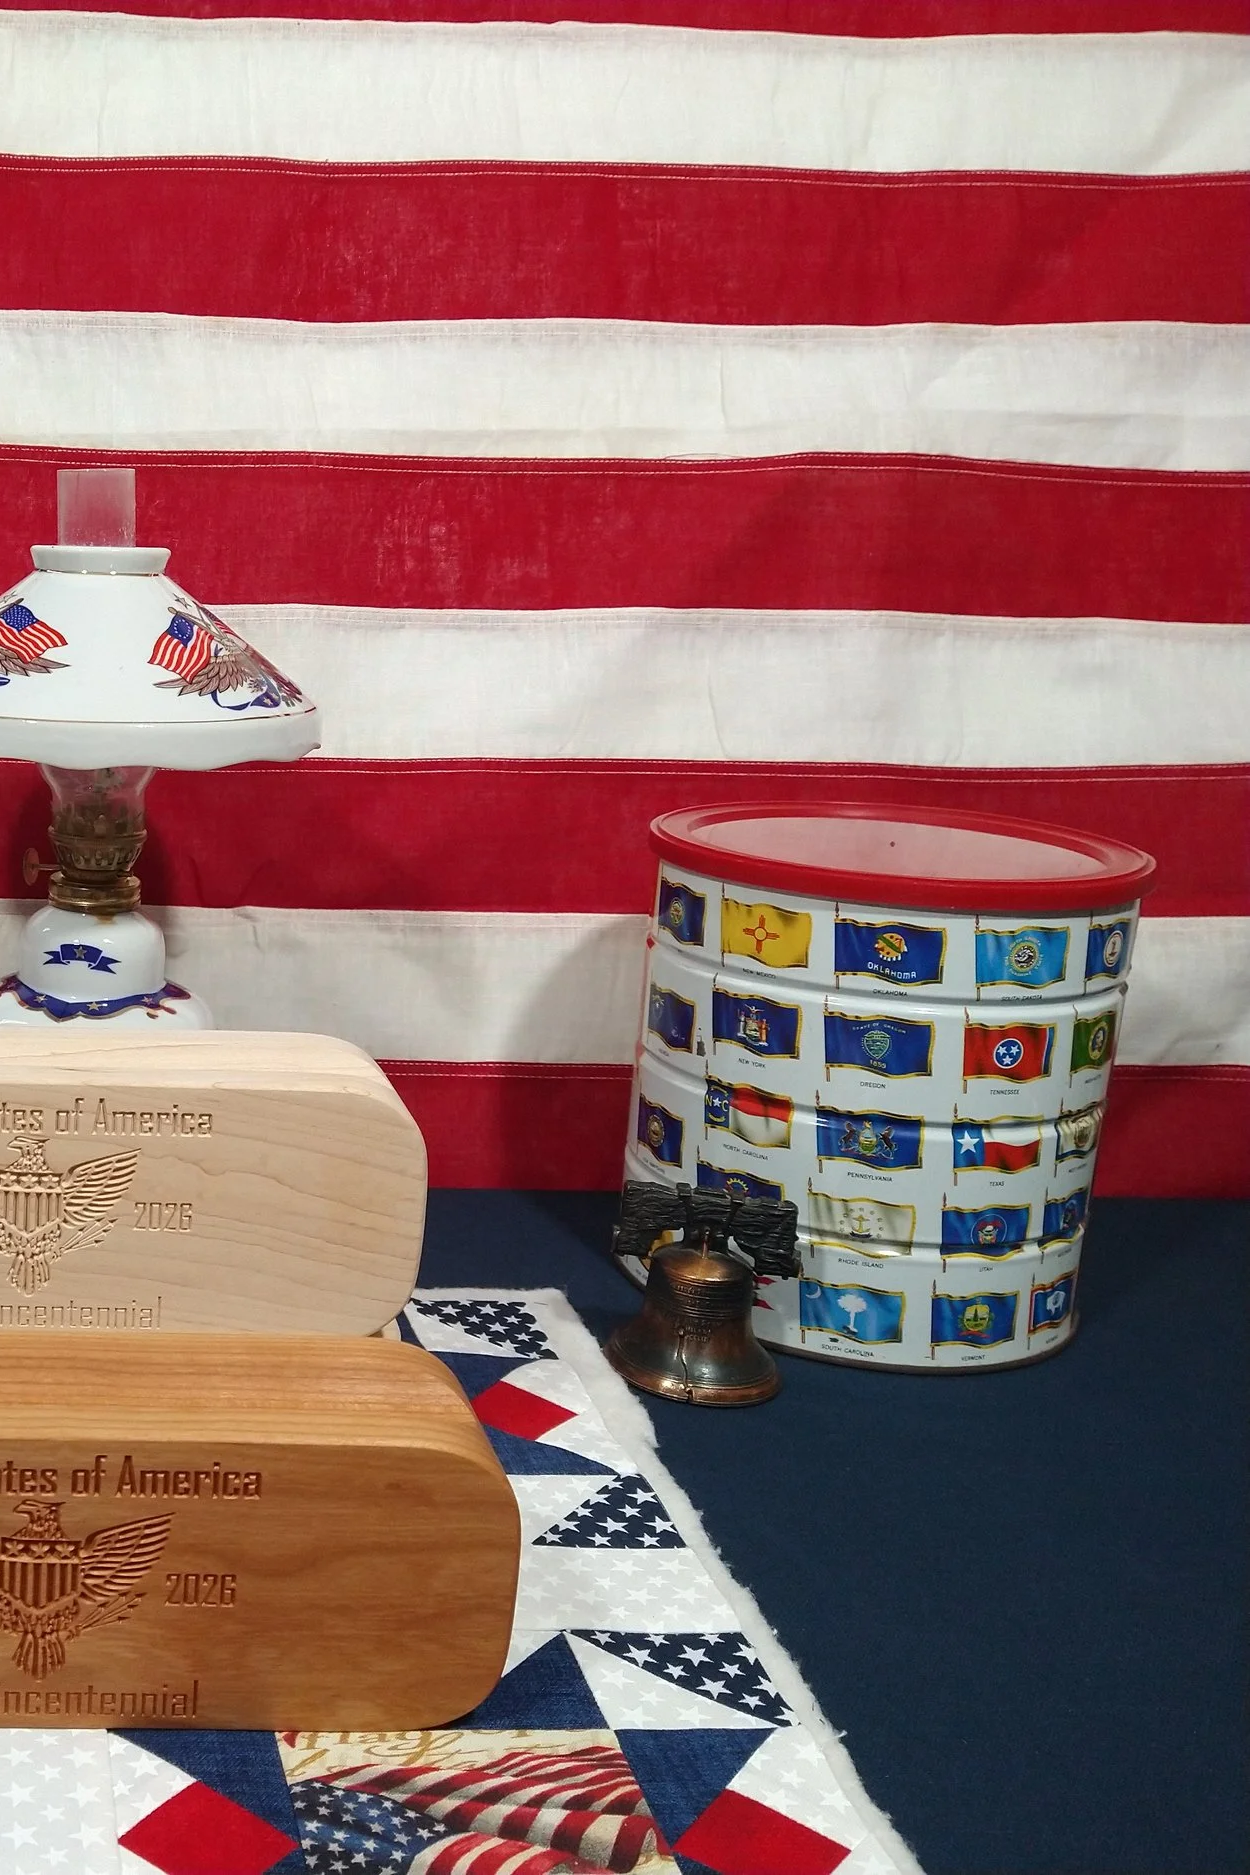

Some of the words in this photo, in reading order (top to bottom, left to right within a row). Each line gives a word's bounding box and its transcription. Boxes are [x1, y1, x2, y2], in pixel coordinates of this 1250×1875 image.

[867, 961, 917, 979] OKLAHOMA
[872, 988, 908, 998] OKLAHOMA
[738, 1057, 750, 1065] NEW
[752, 1060, 766, 1069] YORK
[859, 1081, 887, 1089] OREGON
[55, 1097, 85, 1136] of
[92, 1097, 214, 1138] America
[723, 1143, 741, 1153] NORTH
[742, 1149, 769, 1161] CAROLINA
[847, 1171, 893, 1182] PENNSYLVANIA
[133, 1201, 193, 1233] 2026
[837, 1257, 859, 1266] RHODE
[861, 1261, 884, 1269] ISLAND
[821, 1343, 842, 1352] SOUTH
[844, 1347, 875, 1357] CAROLINA
[71, 1454, 107, 1498] of
[115, 1454, 263, 1501] America
[164, 1572, 237, 1608] 2026
